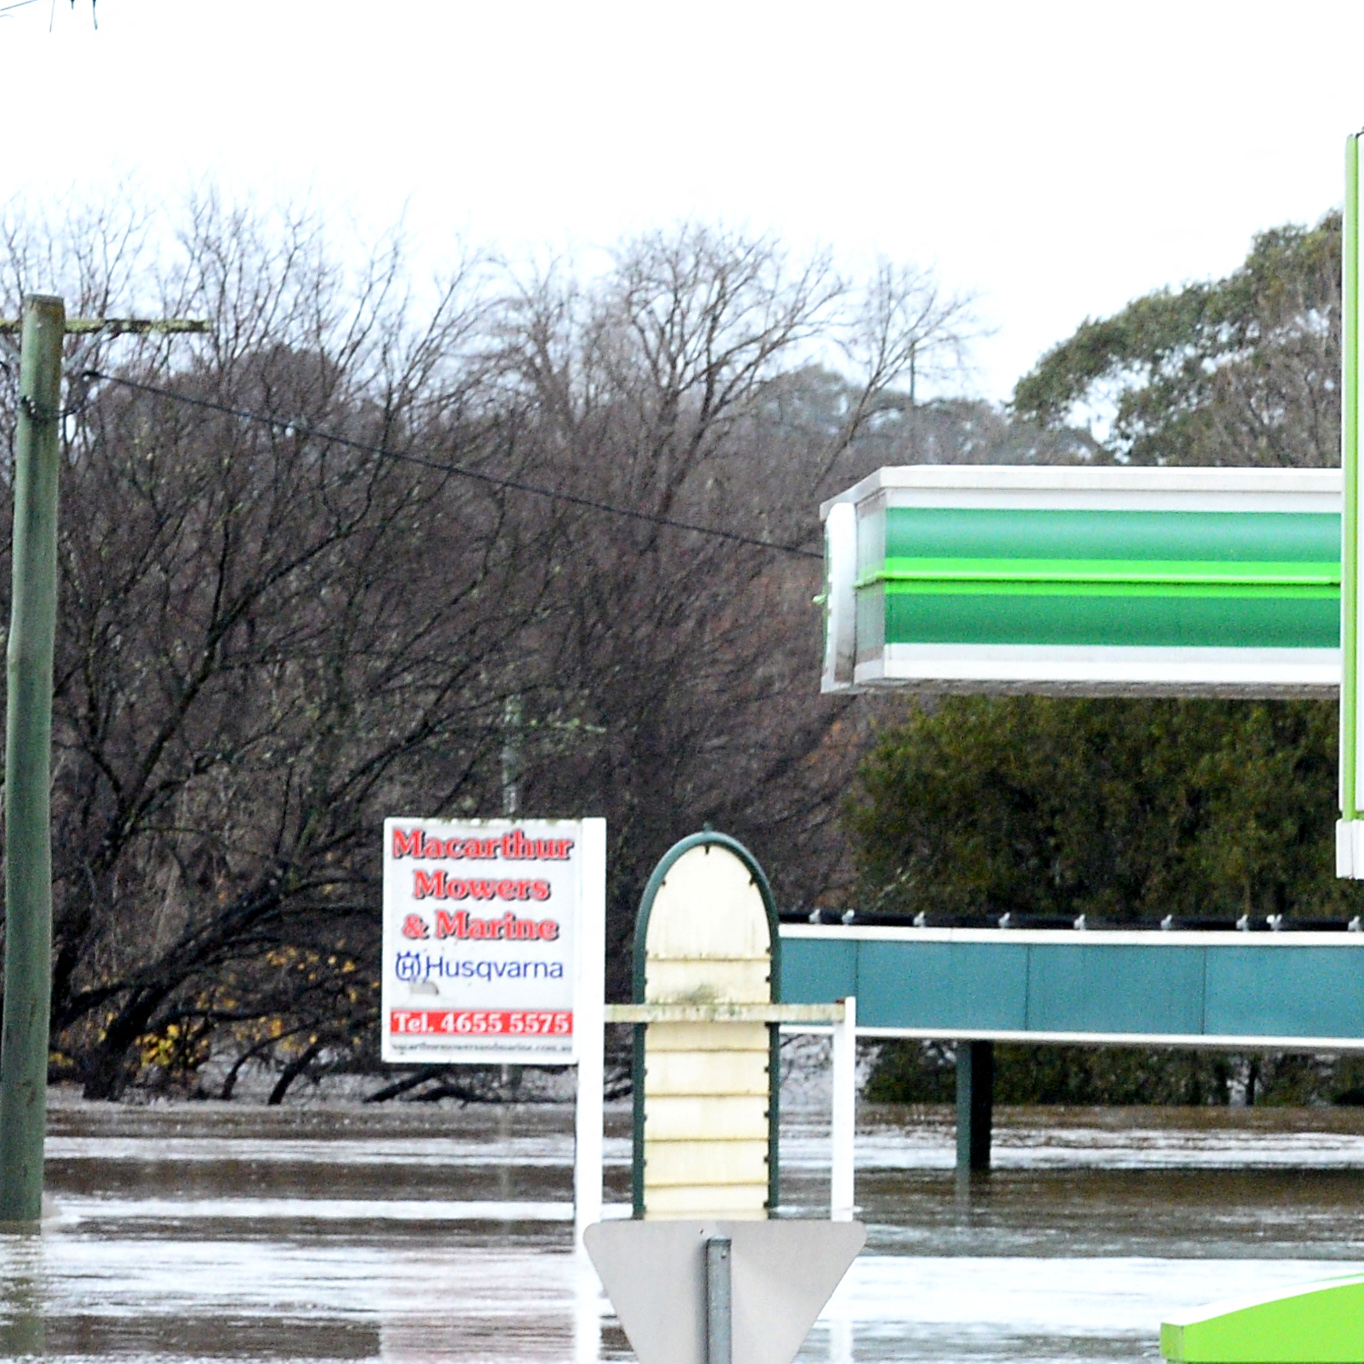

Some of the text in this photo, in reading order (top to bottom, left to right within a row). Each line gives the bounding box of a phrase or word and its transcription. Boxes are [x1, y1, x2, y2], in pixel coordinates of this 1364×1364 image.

[392, 829, 575, 861] Macarthur
[413, 869, 552, 901] Mowers
[402, 909, 560, 941] & Marine
[425, 956, 564, 982] Husqvarna
[394, 1012, 570, 1033] Tel. 4655 5575
